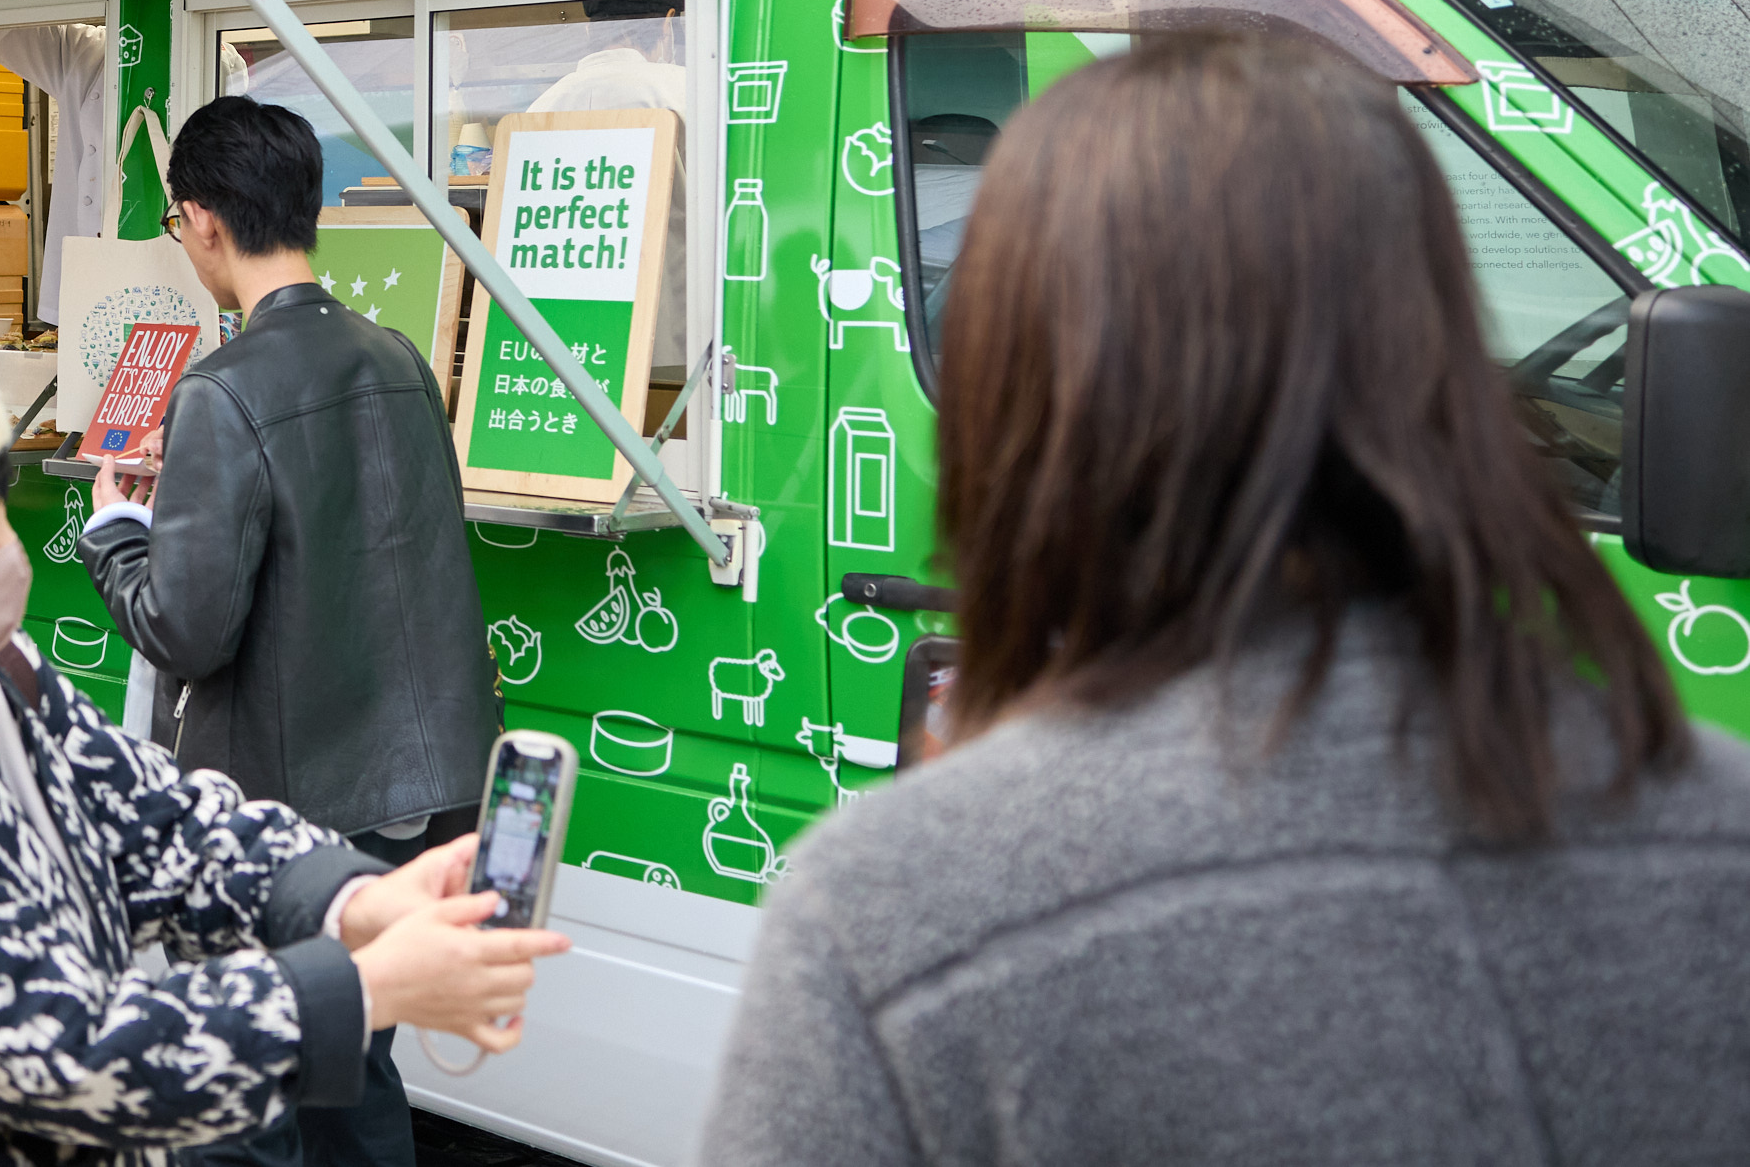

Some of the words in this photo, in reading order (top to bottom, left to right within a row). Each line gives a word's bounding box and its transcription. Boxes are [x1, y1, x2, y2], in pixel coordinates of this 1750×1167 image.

[520, 160, 543, 191] It
[551, 157, 576, 191] is
[585, 156, 635, 190] the
[1468, 171, 1488, 181] four
[1498, 186, 1515, 196] has
[514, 195, 629, 238] perfect
[1495, 214, 1519, 225] With
[1521, 216, 1547, 225] more
[1470, 229, 1523, 241] worldwide,
[1525, 231, 1540, 240] we
[510, 235, 628, 269] match!
[1481, 245, 1521, 257] develop
[1524, 244, 1568, 255] solutions
[1472, 260, 1524, 270] connected
[1526, 259, 1583, 272] challenges.
[122, 330, 189, 370] ENJOY
[111, 368, 138, 394] IT'S
[133, 369, 172, 396] FROM
[97, 393, 160, 427] EUROPE
[488, 407, 578, 434] 出合うとき
